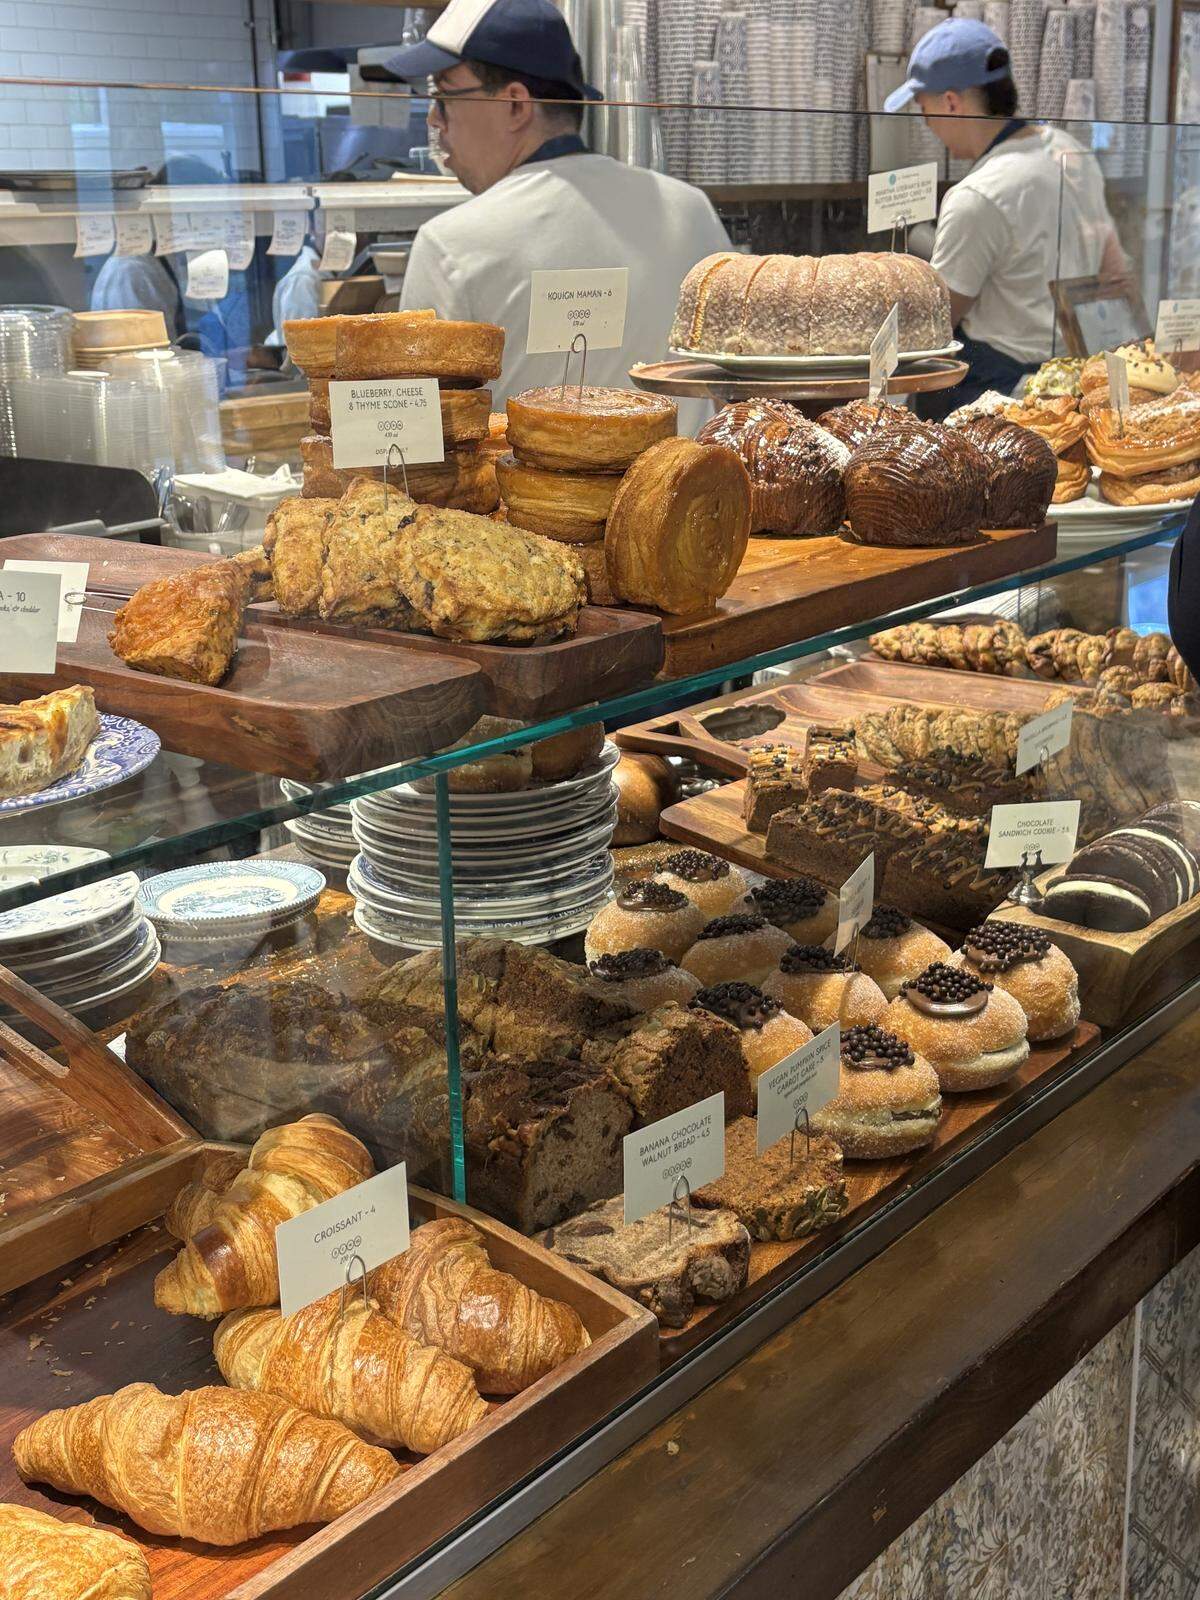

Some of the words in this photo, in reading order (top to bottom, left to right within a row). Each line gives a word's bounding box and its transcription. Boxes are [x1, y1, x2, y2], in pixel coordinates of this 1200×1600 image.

[547, 291, 575, 300] KOUIGN
[576, 289, 602, 299] MAMAN
[396, 387, 424, 397] CHEESE
[356, 400, 381, 411] THYME
[383, 399, 408, 409] SCONE
[375, 447, 394, 455] DISPLY
[16, 591, 26, 602] 10
[1016, 818, 1055, 828] CHOCOLATE
[998, 829, 1032, 838] SANDWICH
[1032, 827, 1056, 836] COOKIE
[768, 1072, 788, 1090] VEGAN
[790, 1051, 815, 1074] PUMPKIN
[815, 1038, 832, 1056] SPICE
[776, 1073, 799, 1095] CARROT
[800, 1061, 816, 1078] CAKE
[639, 1135, 670, 1157] BANANA
[671, 1115, 712, 1142] CHOCOLATE
[641, 1146, 672, 1168] WALNUT
[673, 1135, 696, 1153] BREAD
[313, 1210, 363, 1244] CROISSANT
[370, 1204, 376, 1214] 4
